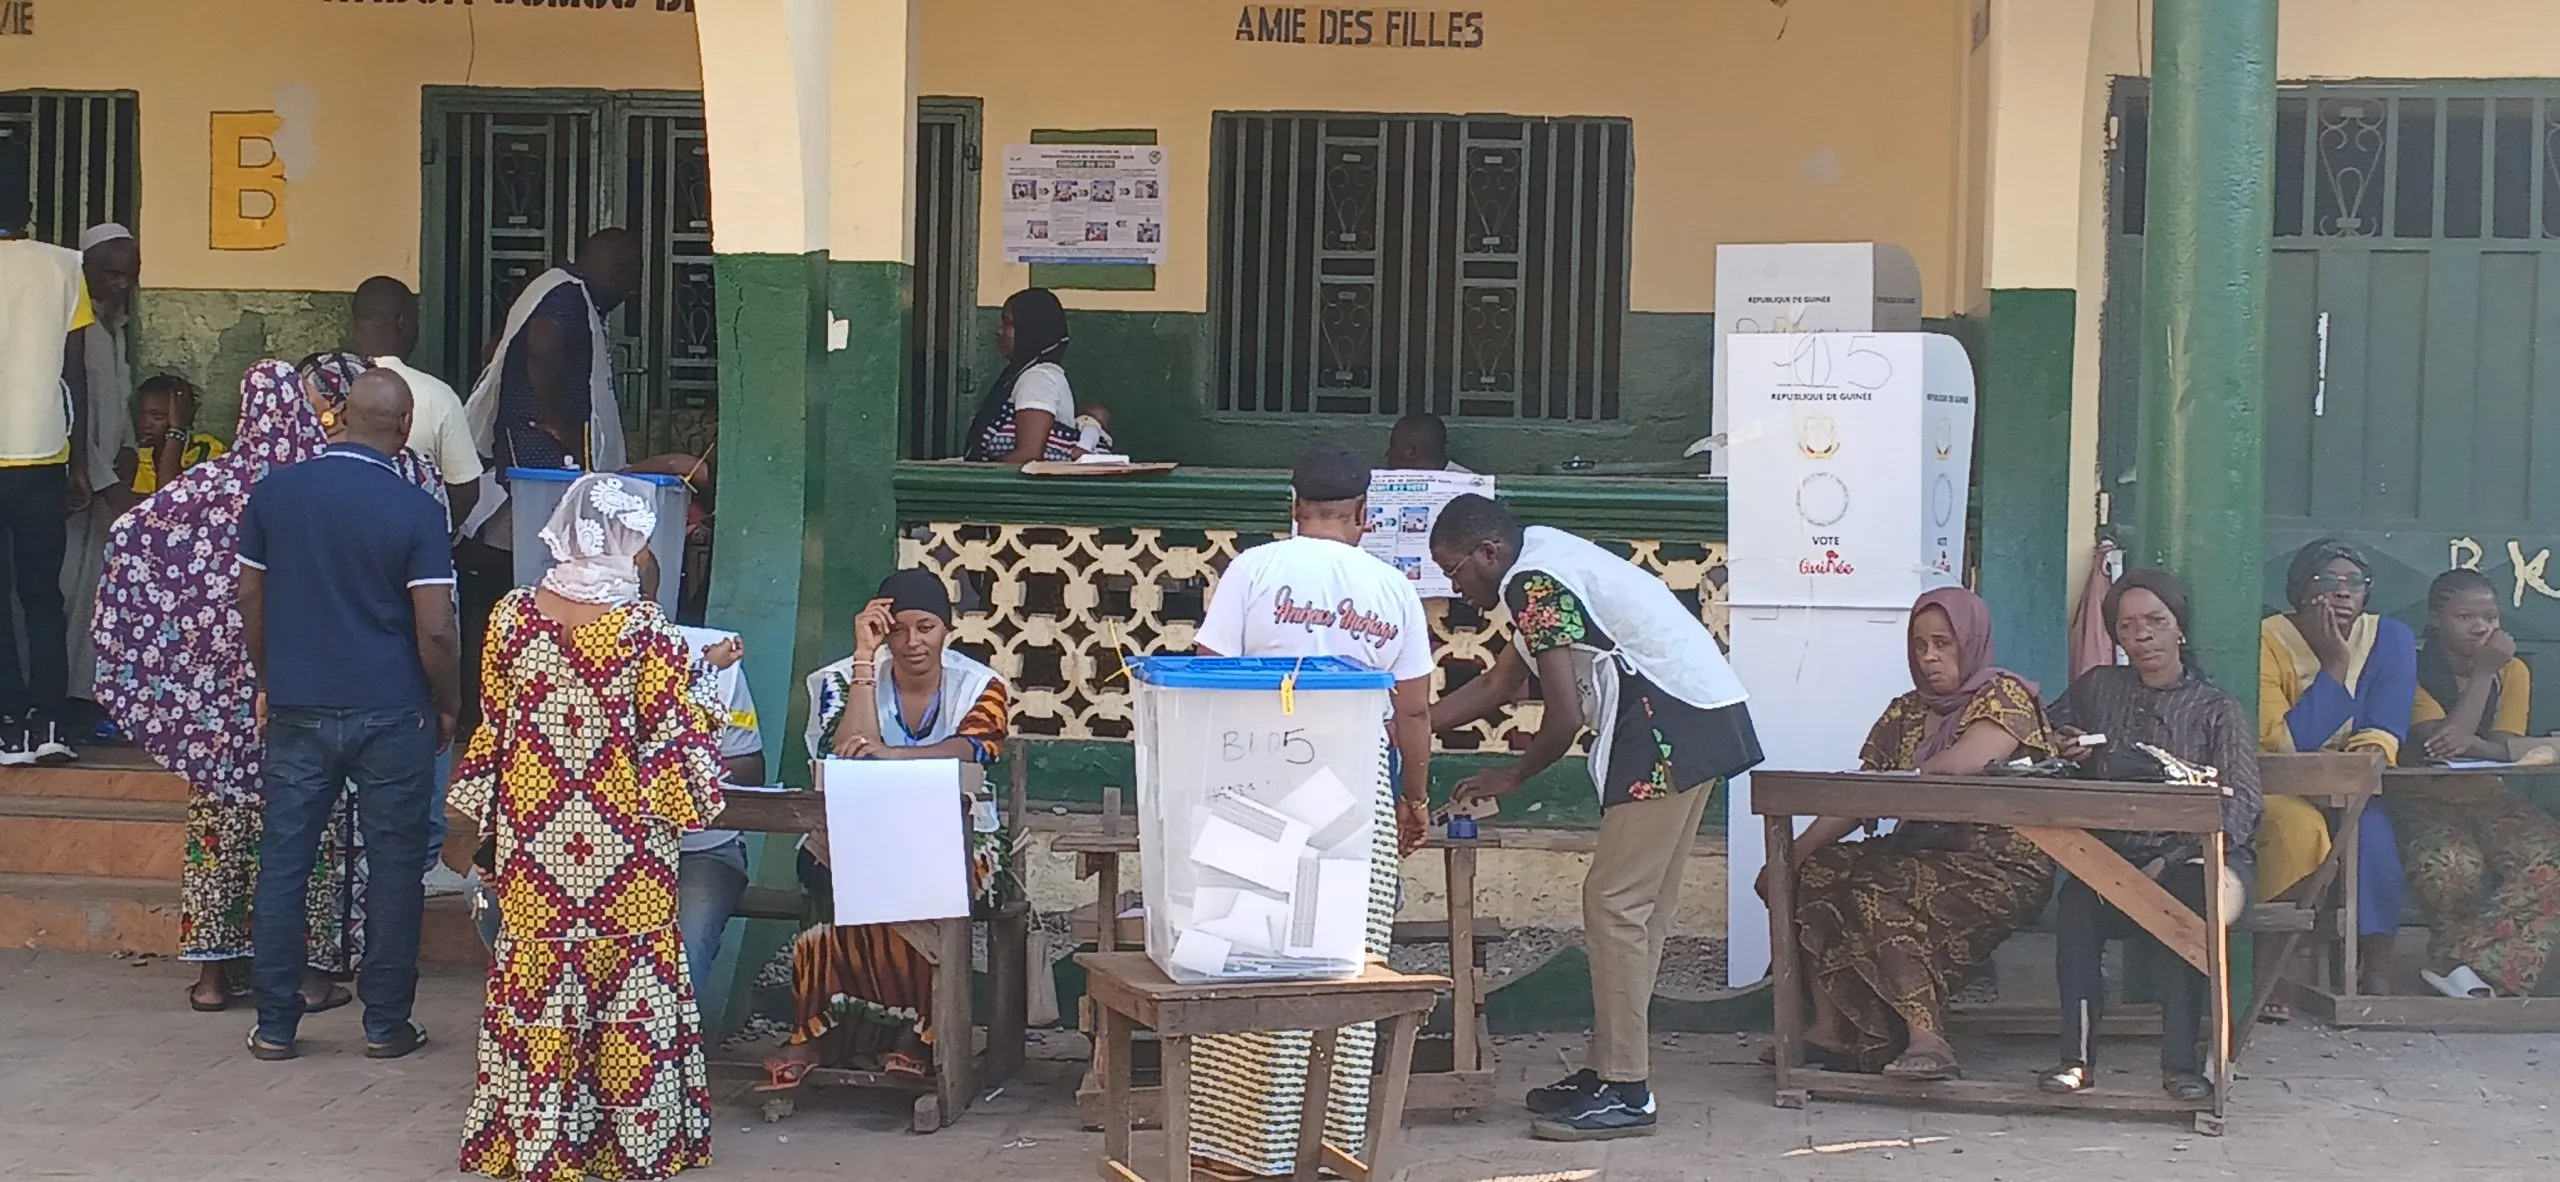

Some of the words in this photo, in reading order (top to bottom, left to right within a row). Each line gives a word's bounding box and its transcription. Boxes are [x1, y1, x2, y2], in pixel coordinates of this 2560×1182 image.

[1235, 6, 1306, 44] AMIE
[1318, 9, 1374, 46] DES
[1386, 11, 1484, 49] FILLES
[1826, 393, 1837, 401] DE
[1812, 536, 1840, 546] VOTE
